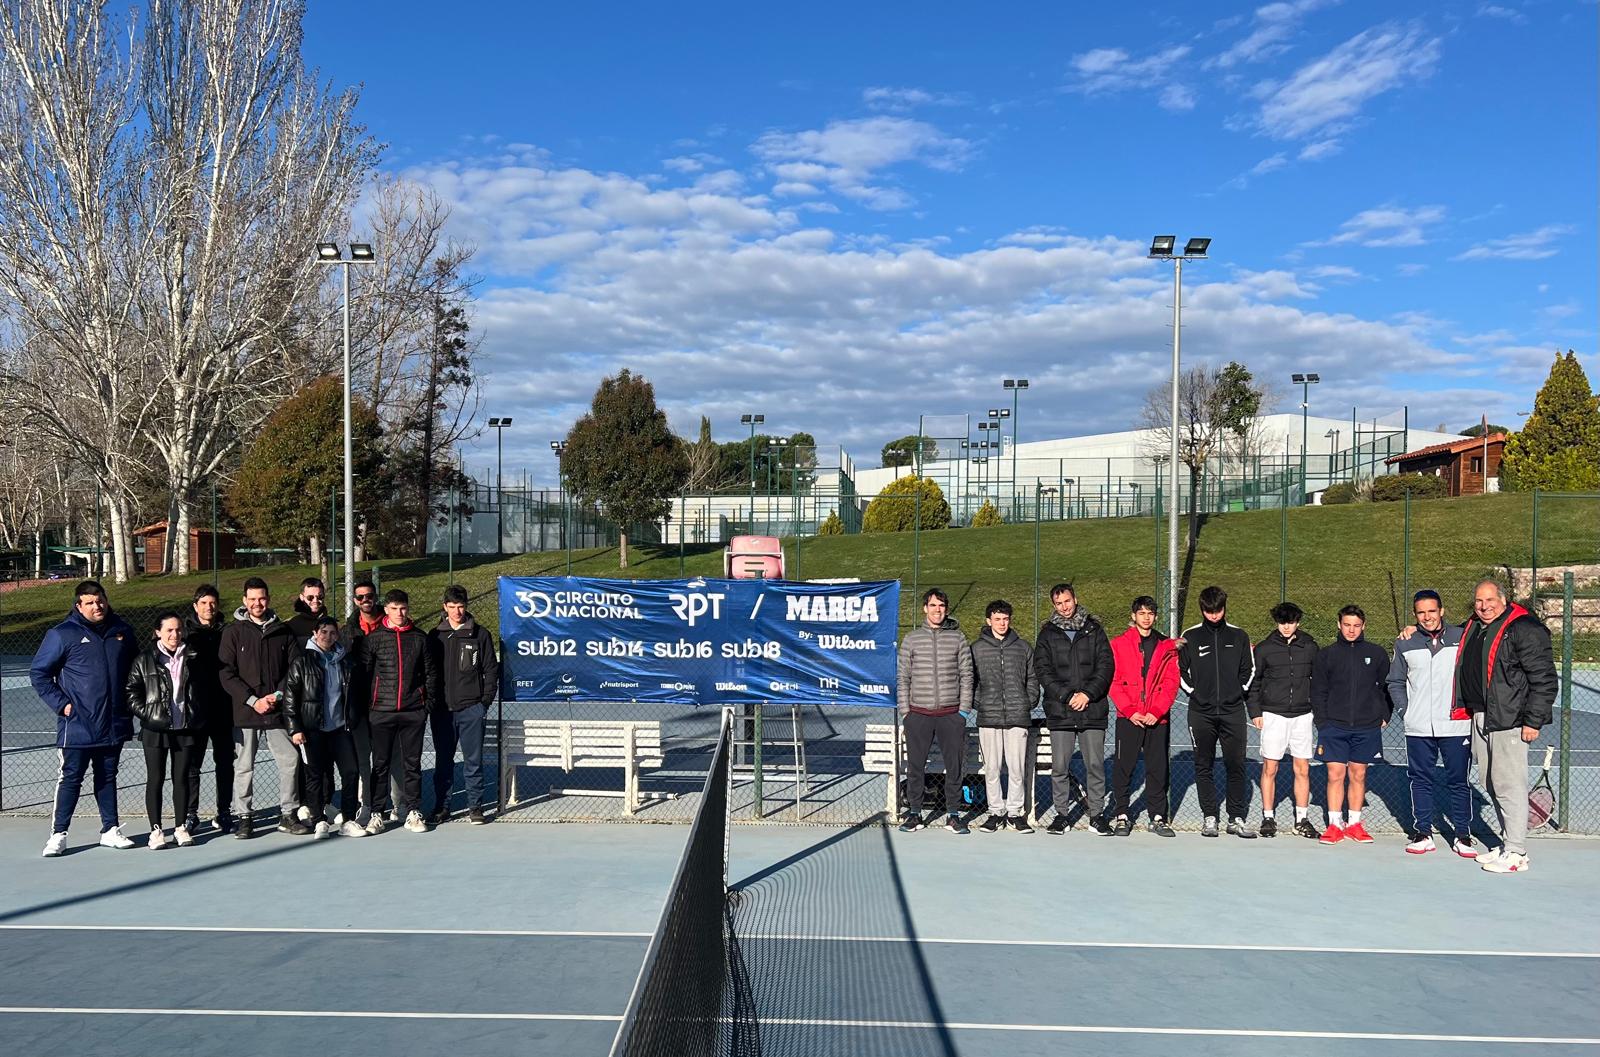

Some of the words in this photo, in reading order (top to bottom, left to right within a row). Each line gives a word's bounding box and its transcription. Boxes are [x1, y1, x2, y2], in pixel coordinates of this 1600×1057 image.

[513, 591, 552, 618] 30
[554, 591, 634, 606] CIRCUITO
[555, 605, 643, 620] NACIONAL
[668, 592, 726, 627] RPT
[786, 595, 879, 622] MARCA
[517, 636, 577, 656] sub12
[585, 636, 644, 657] sub14
[653, 638, 713, 659] sub16
[721, 638, 781, 659] sub18
[798, 631, 814, 641] By:
[817, 634, 877, 650] Wilson
[715, 682, 748, 691] Wilson
[860, 684, 890, 694] MARCA
